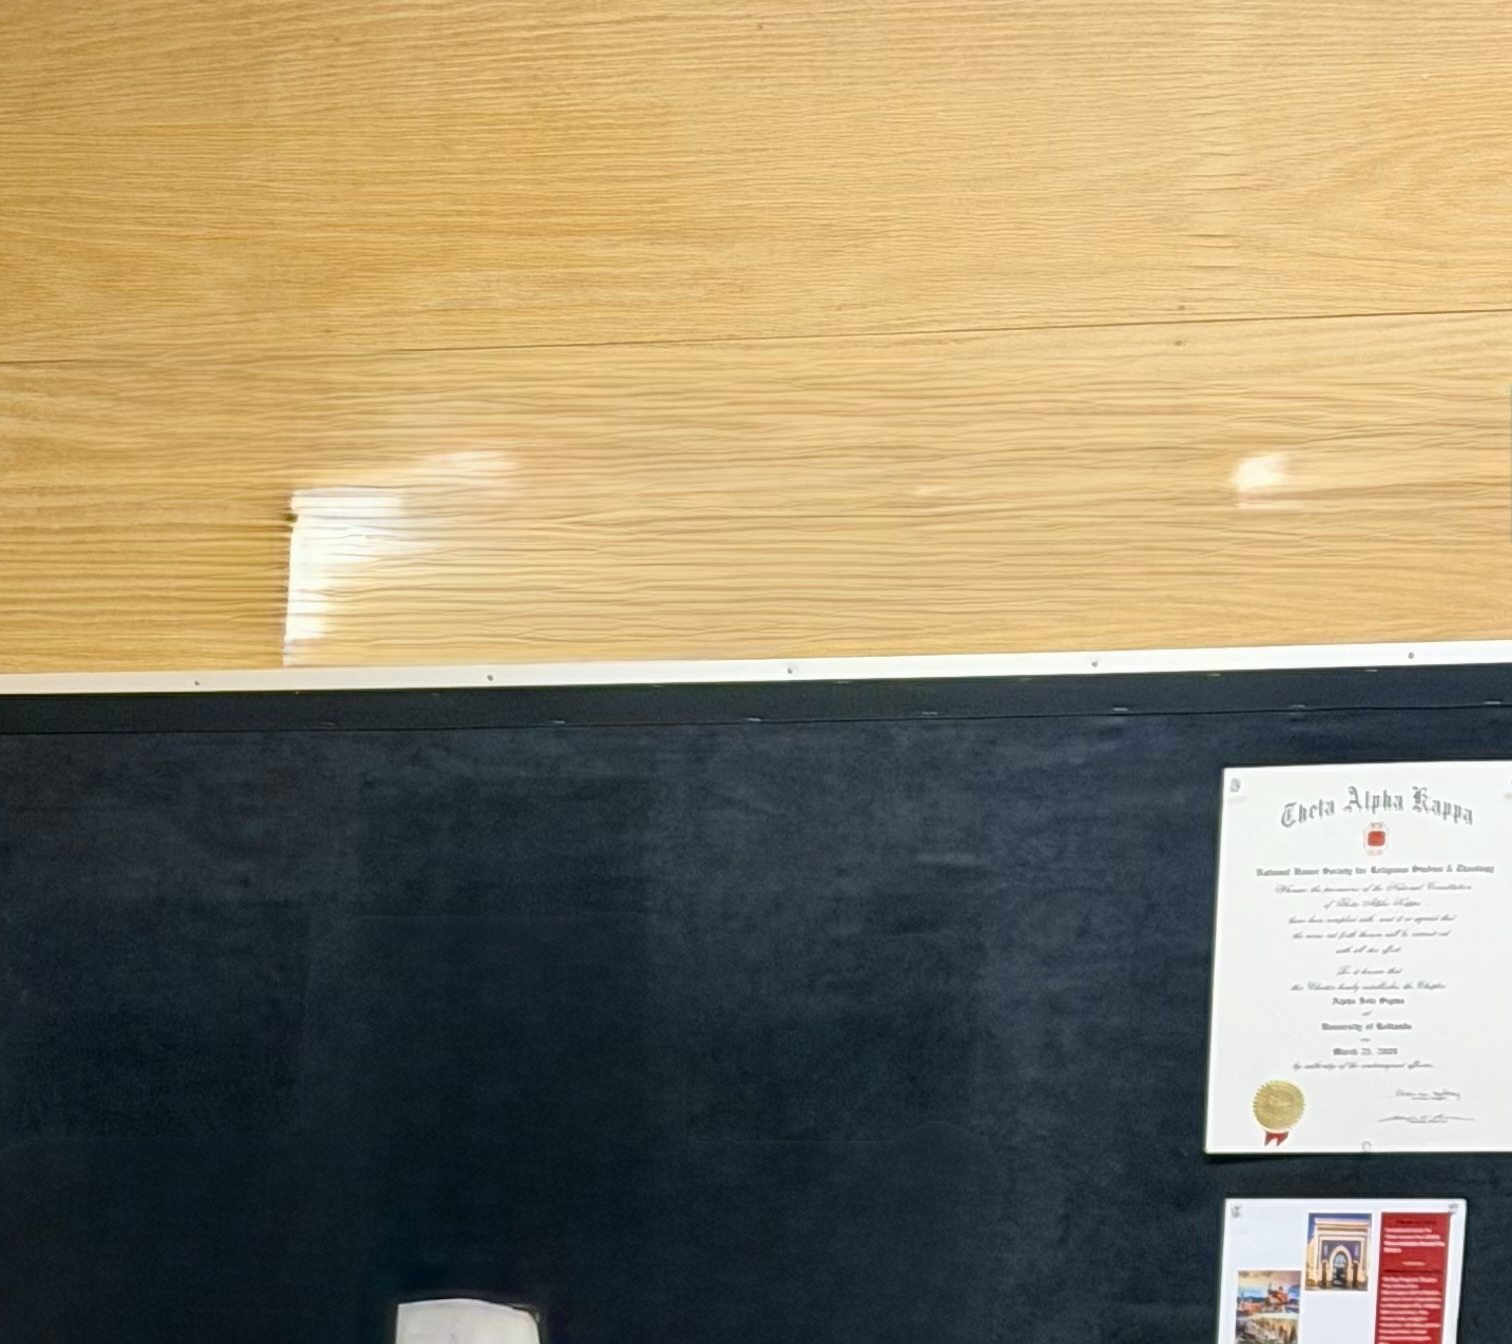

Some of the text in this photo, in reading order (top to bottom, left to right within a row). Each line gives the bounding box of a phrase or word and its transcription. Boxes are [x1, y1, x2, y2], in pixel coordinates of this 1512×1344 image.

[1280, 786, 1473, 828] Theta Alpha Kappa
